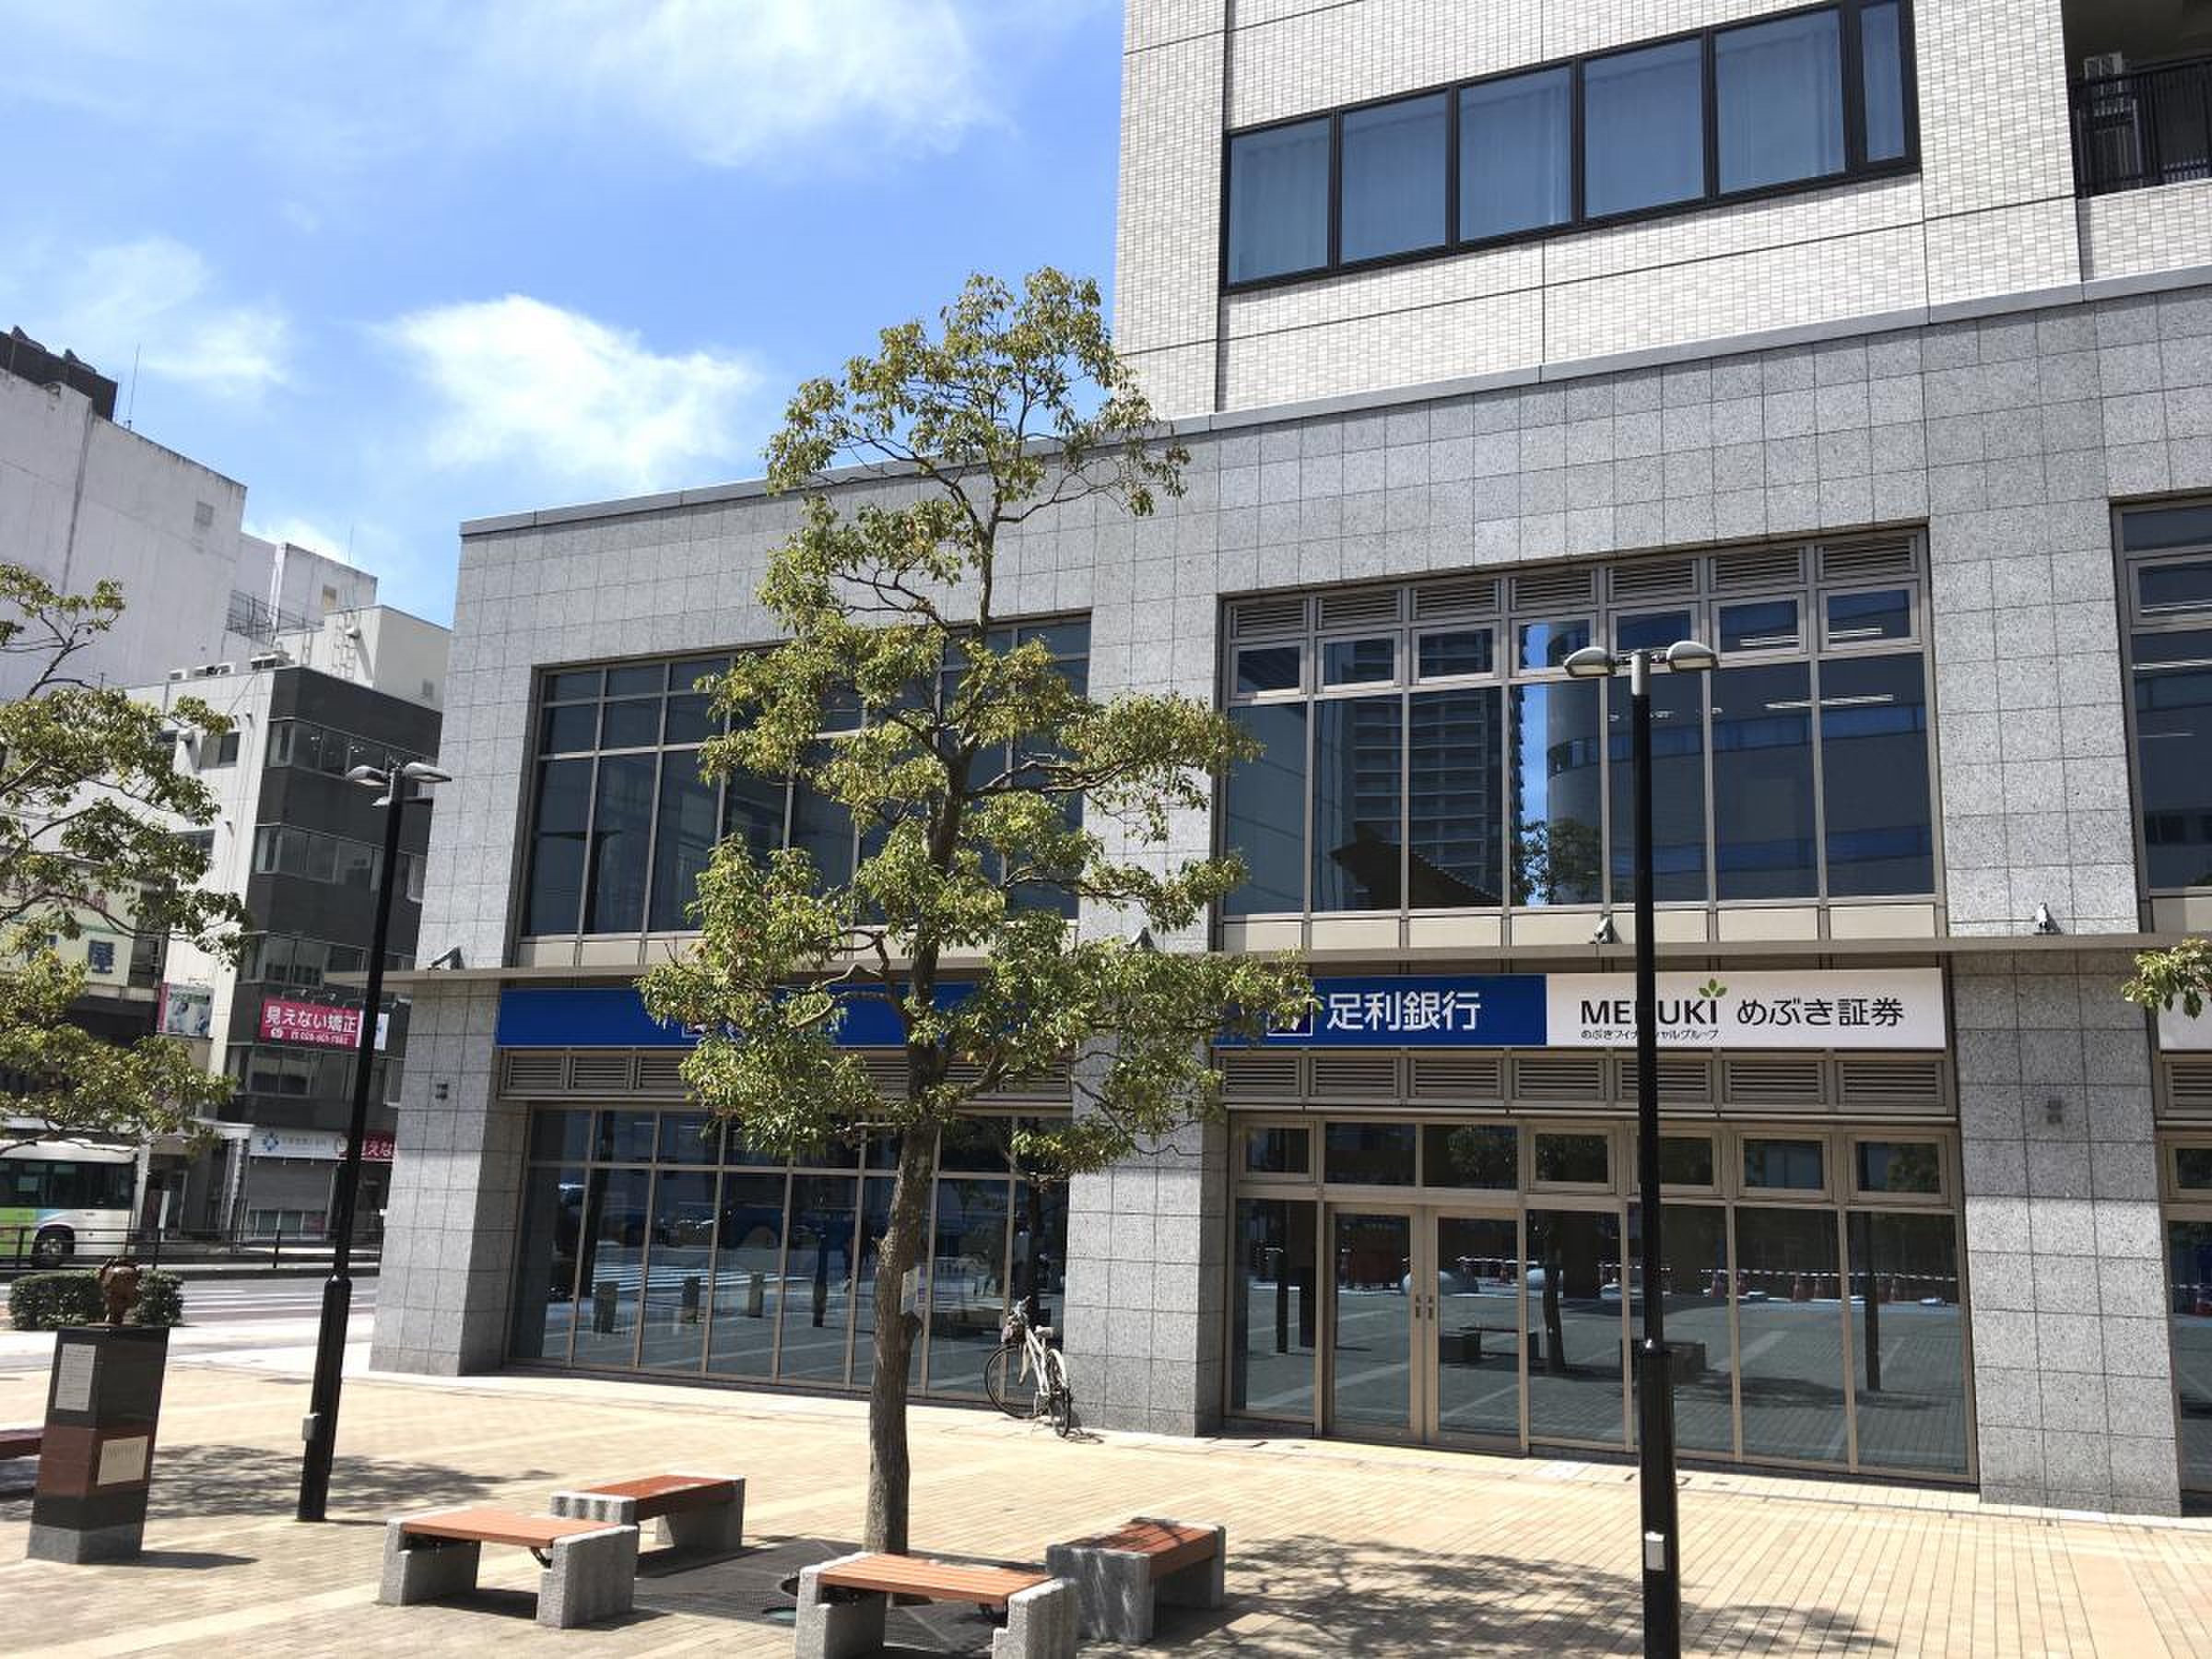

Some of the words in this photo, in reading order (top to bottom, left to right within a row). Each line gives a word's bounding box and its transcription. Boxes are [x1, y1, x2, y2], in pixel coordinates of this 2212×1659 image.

[265, 1006, 358, 1033] 見えない矯正
[1326, 990, 1481, 1031] 足利銀行
[1581, 1000, 1717, 1025] MEUKI
[1736, 997, 1904, 1027] めぶき証券
